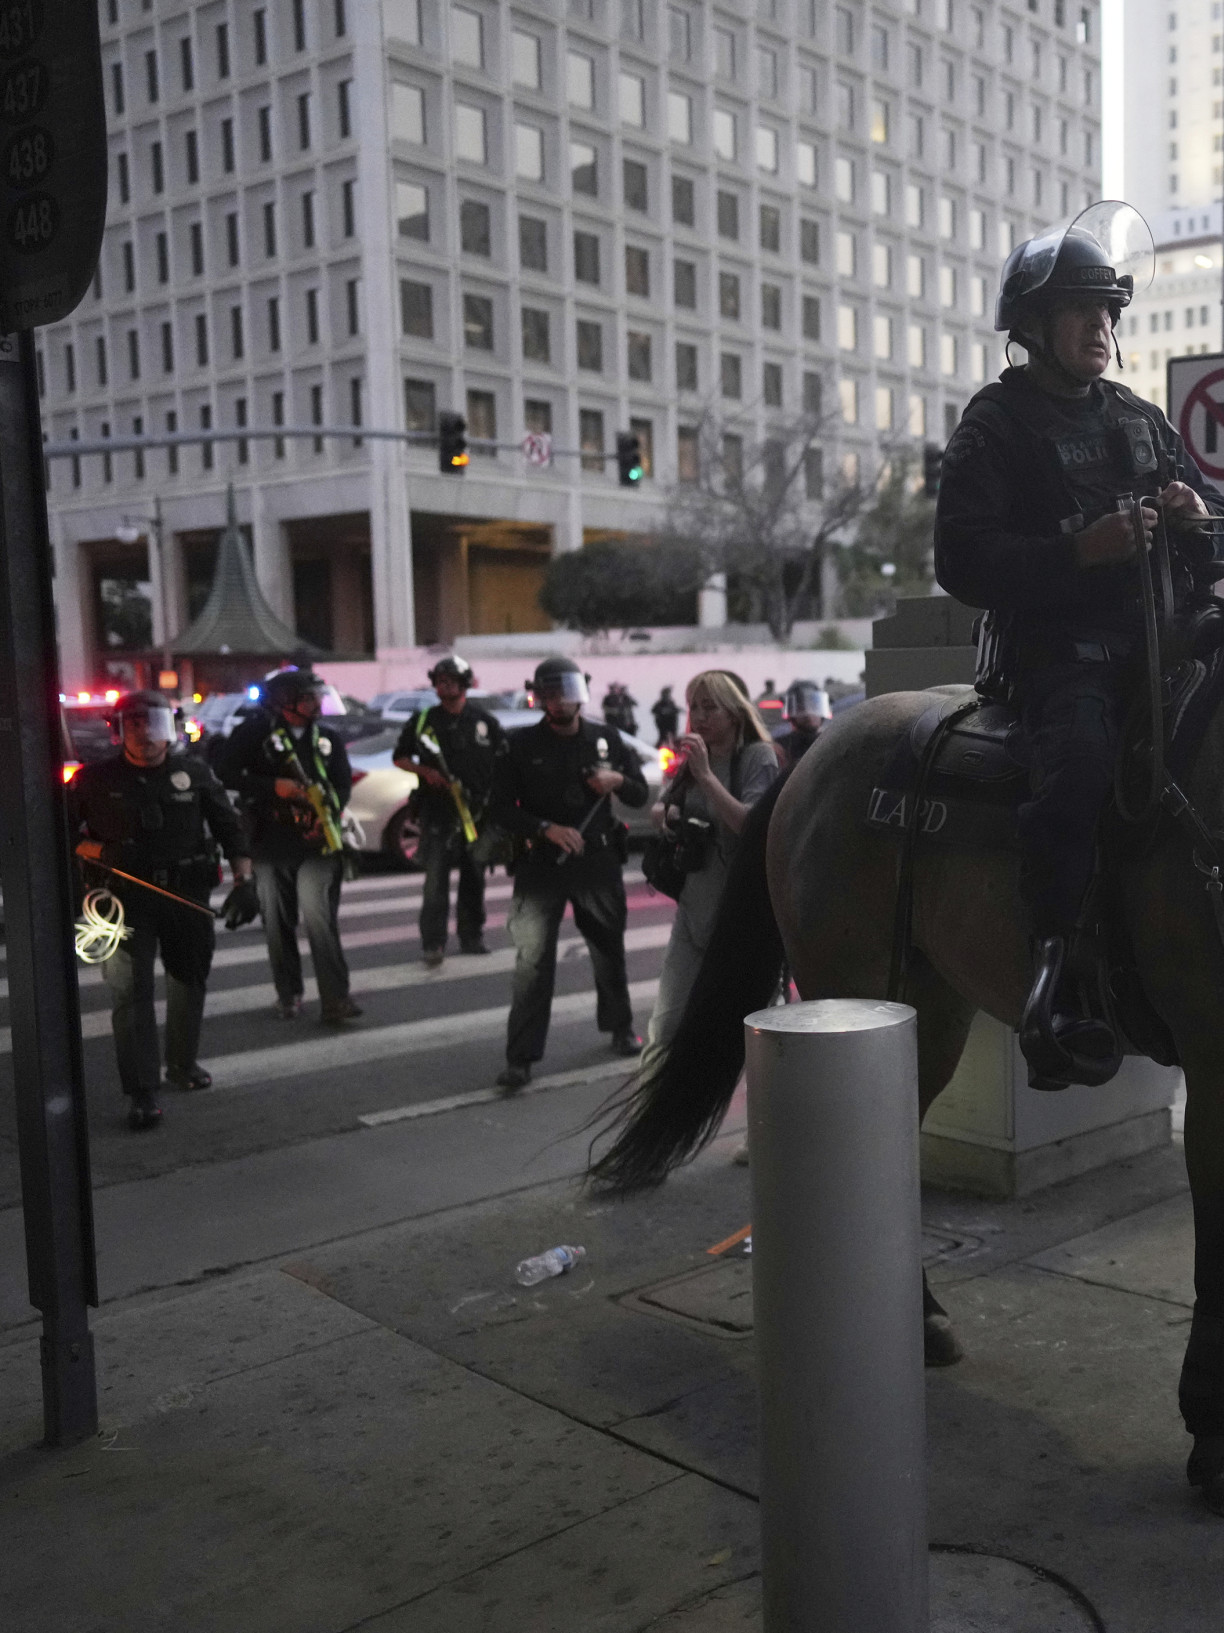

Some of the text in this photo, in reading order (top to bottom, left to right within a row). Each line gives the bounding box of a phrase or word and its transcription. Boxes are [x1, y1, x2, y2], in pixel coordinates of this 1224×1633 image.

[4, 66, 40, 116] 437
[10, 133, 47, 181] 438
[15, 200, 52, 246] 448
[1060, 446, 1108, 465] POLI
